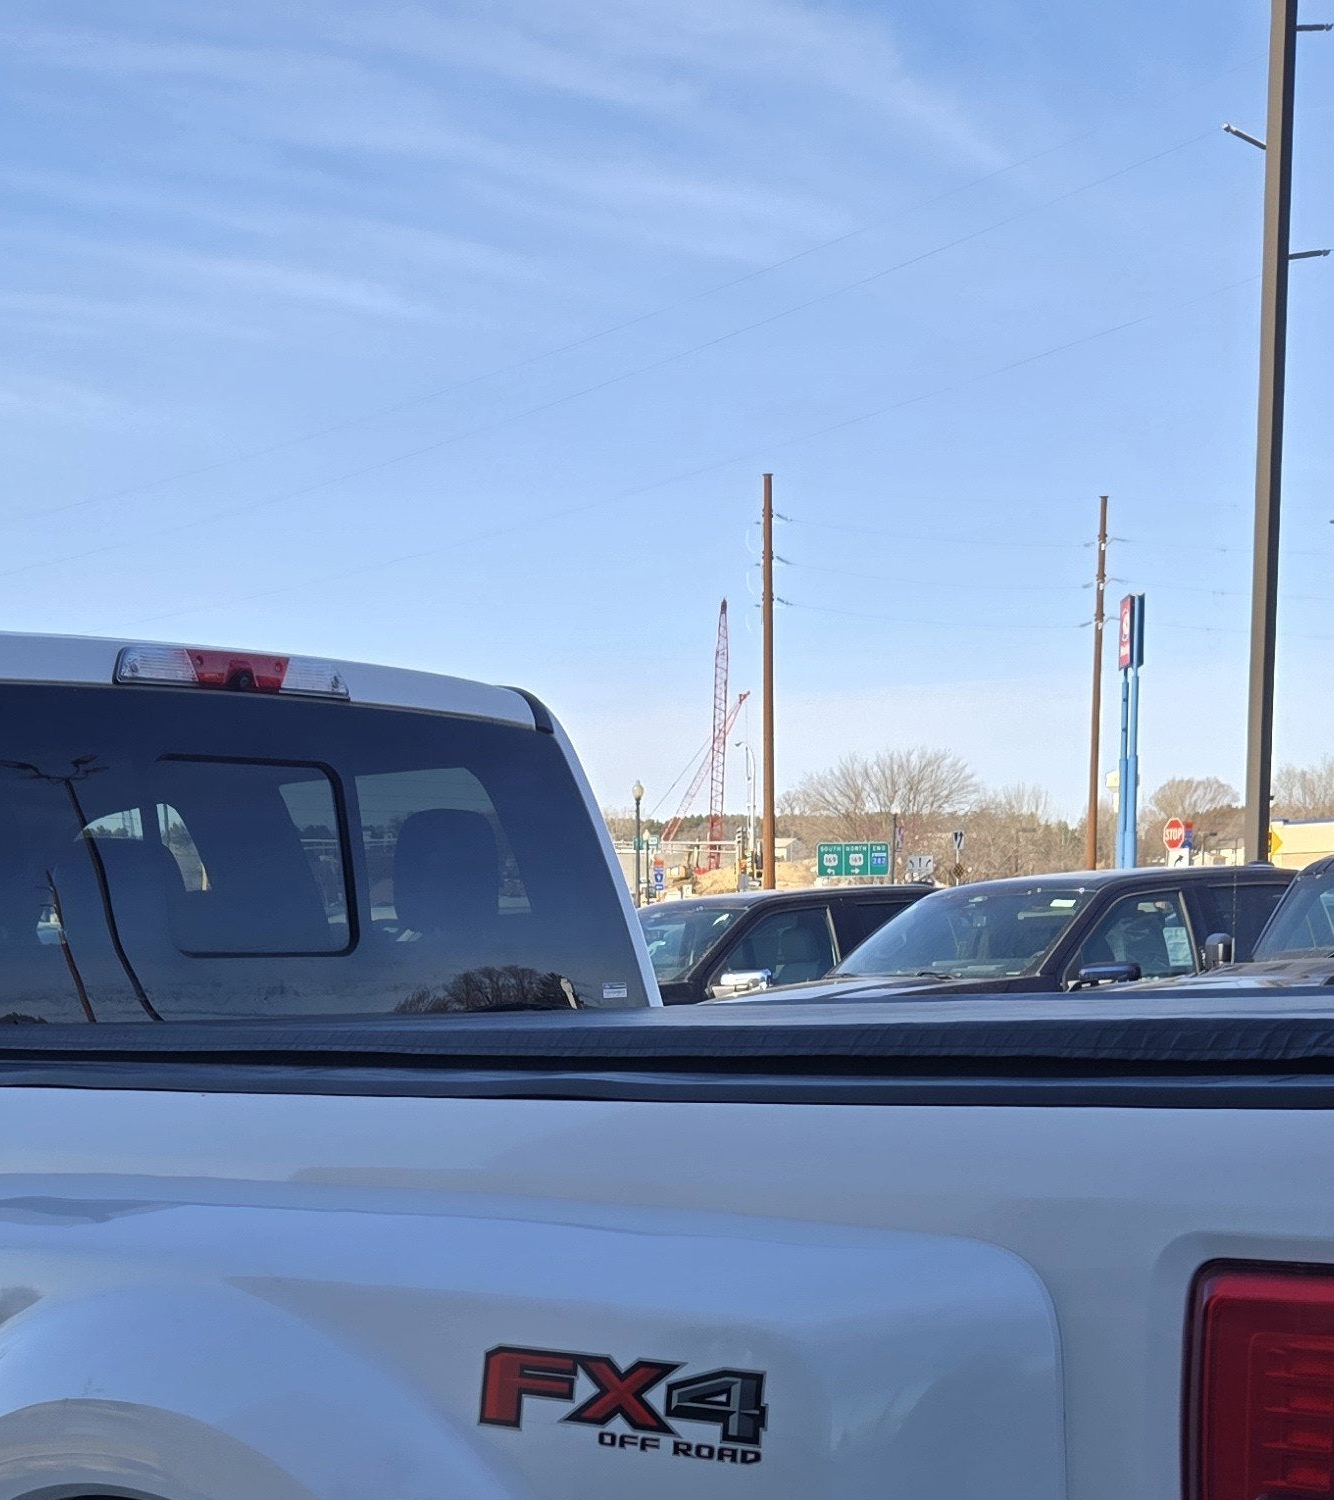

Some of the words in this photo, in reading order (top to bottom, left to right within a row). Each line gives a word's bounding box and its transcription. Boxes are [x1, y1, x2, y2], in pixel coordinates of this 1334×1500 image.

[1165, 827, 1183, 841] STOP
[477, 1343, 769, 1449] FX4
[597, 1431, 660, 1453] OFF
[672, 1440, 762, 1465] ROAD
